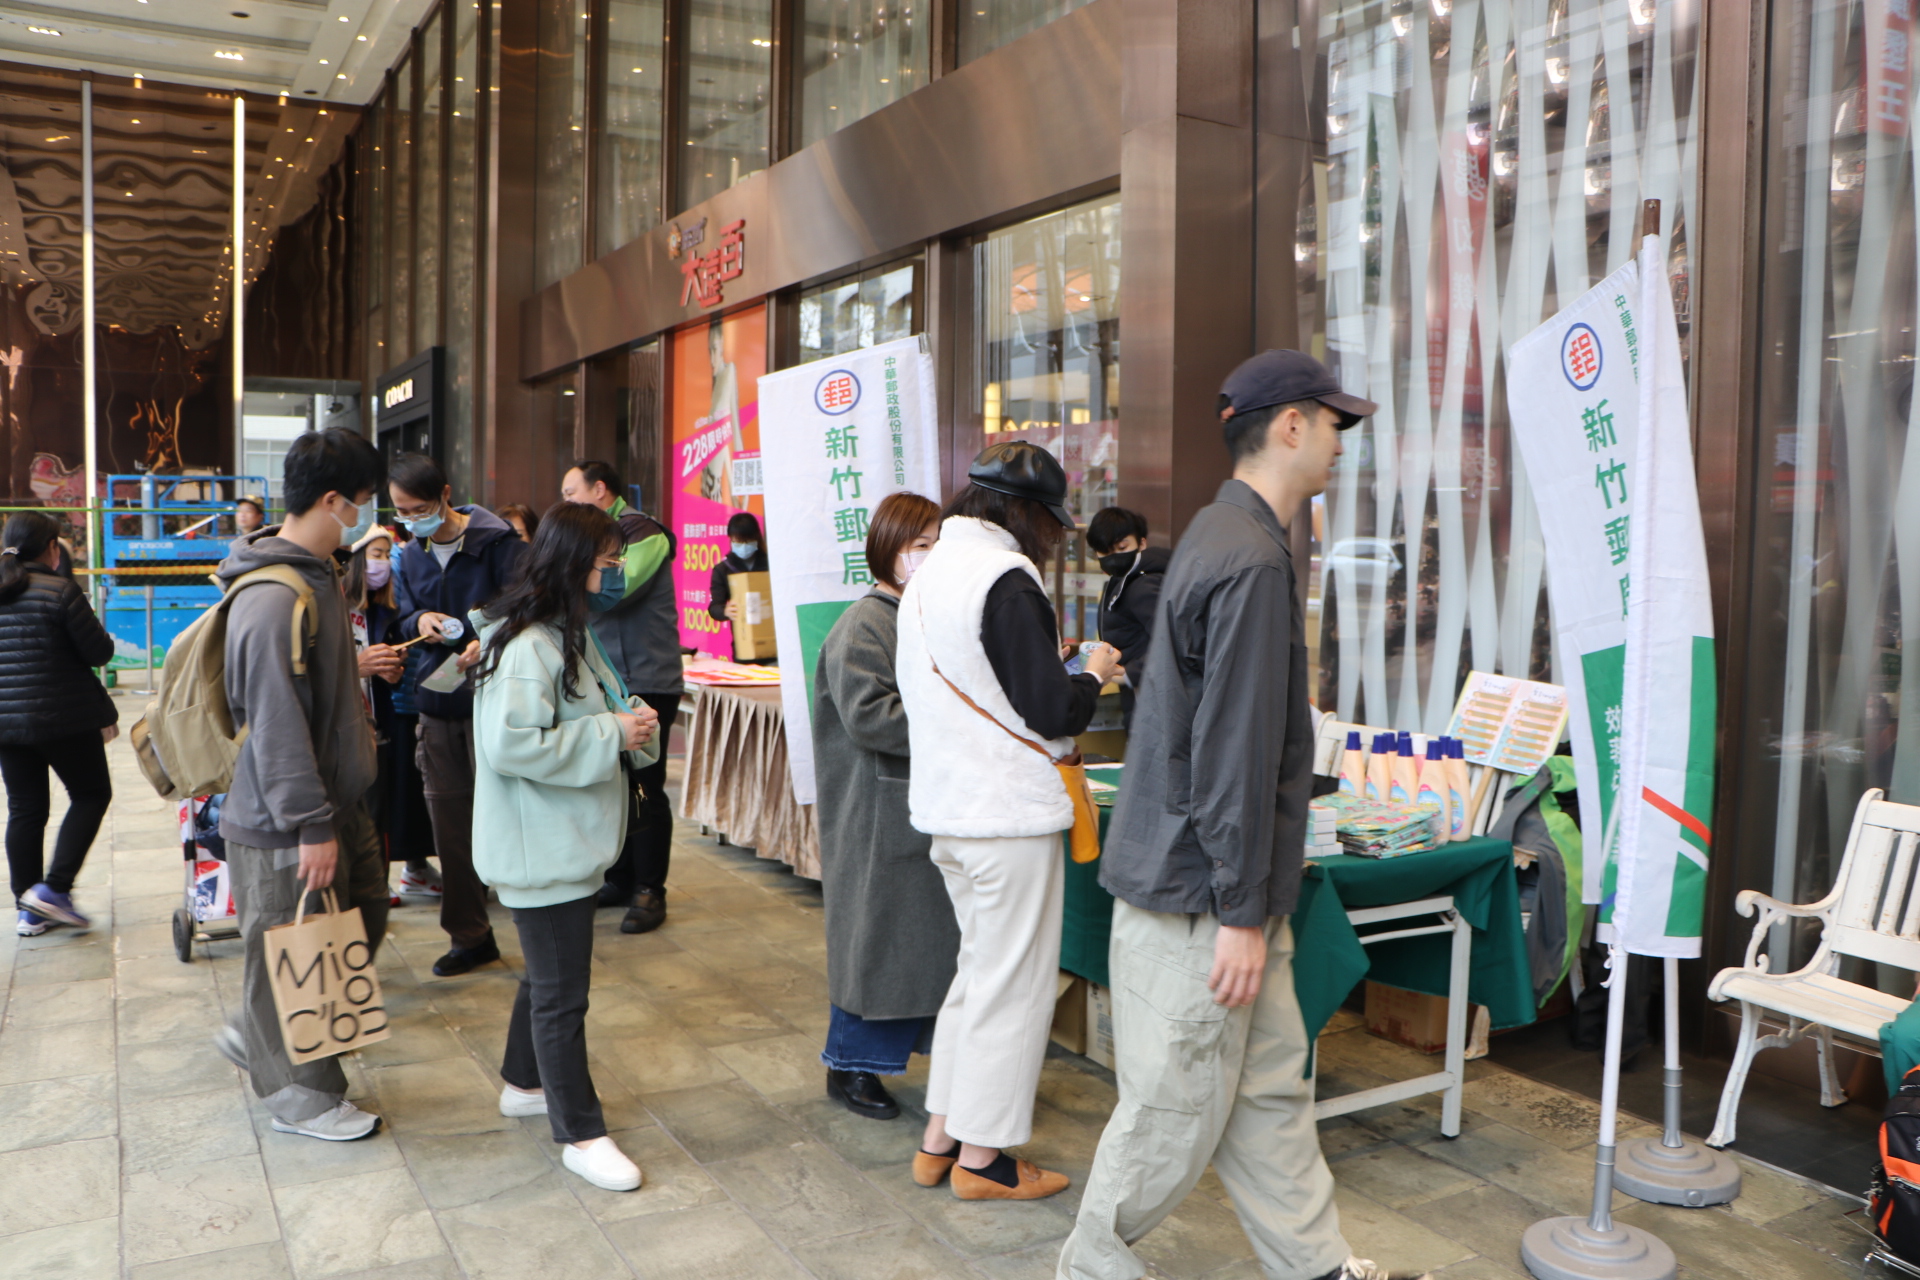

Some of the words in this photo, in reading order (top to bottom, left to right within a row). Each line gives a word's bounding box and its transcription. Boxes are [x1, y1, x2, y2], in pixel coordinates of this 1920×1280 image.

[679, 219, 746, 308] 大遠百
[884, 356, 905, 486] 中華郵政股份有限公司
[684, 543, 721, 572] 3500
[825, 424, 875, 586] 新竹郵局
